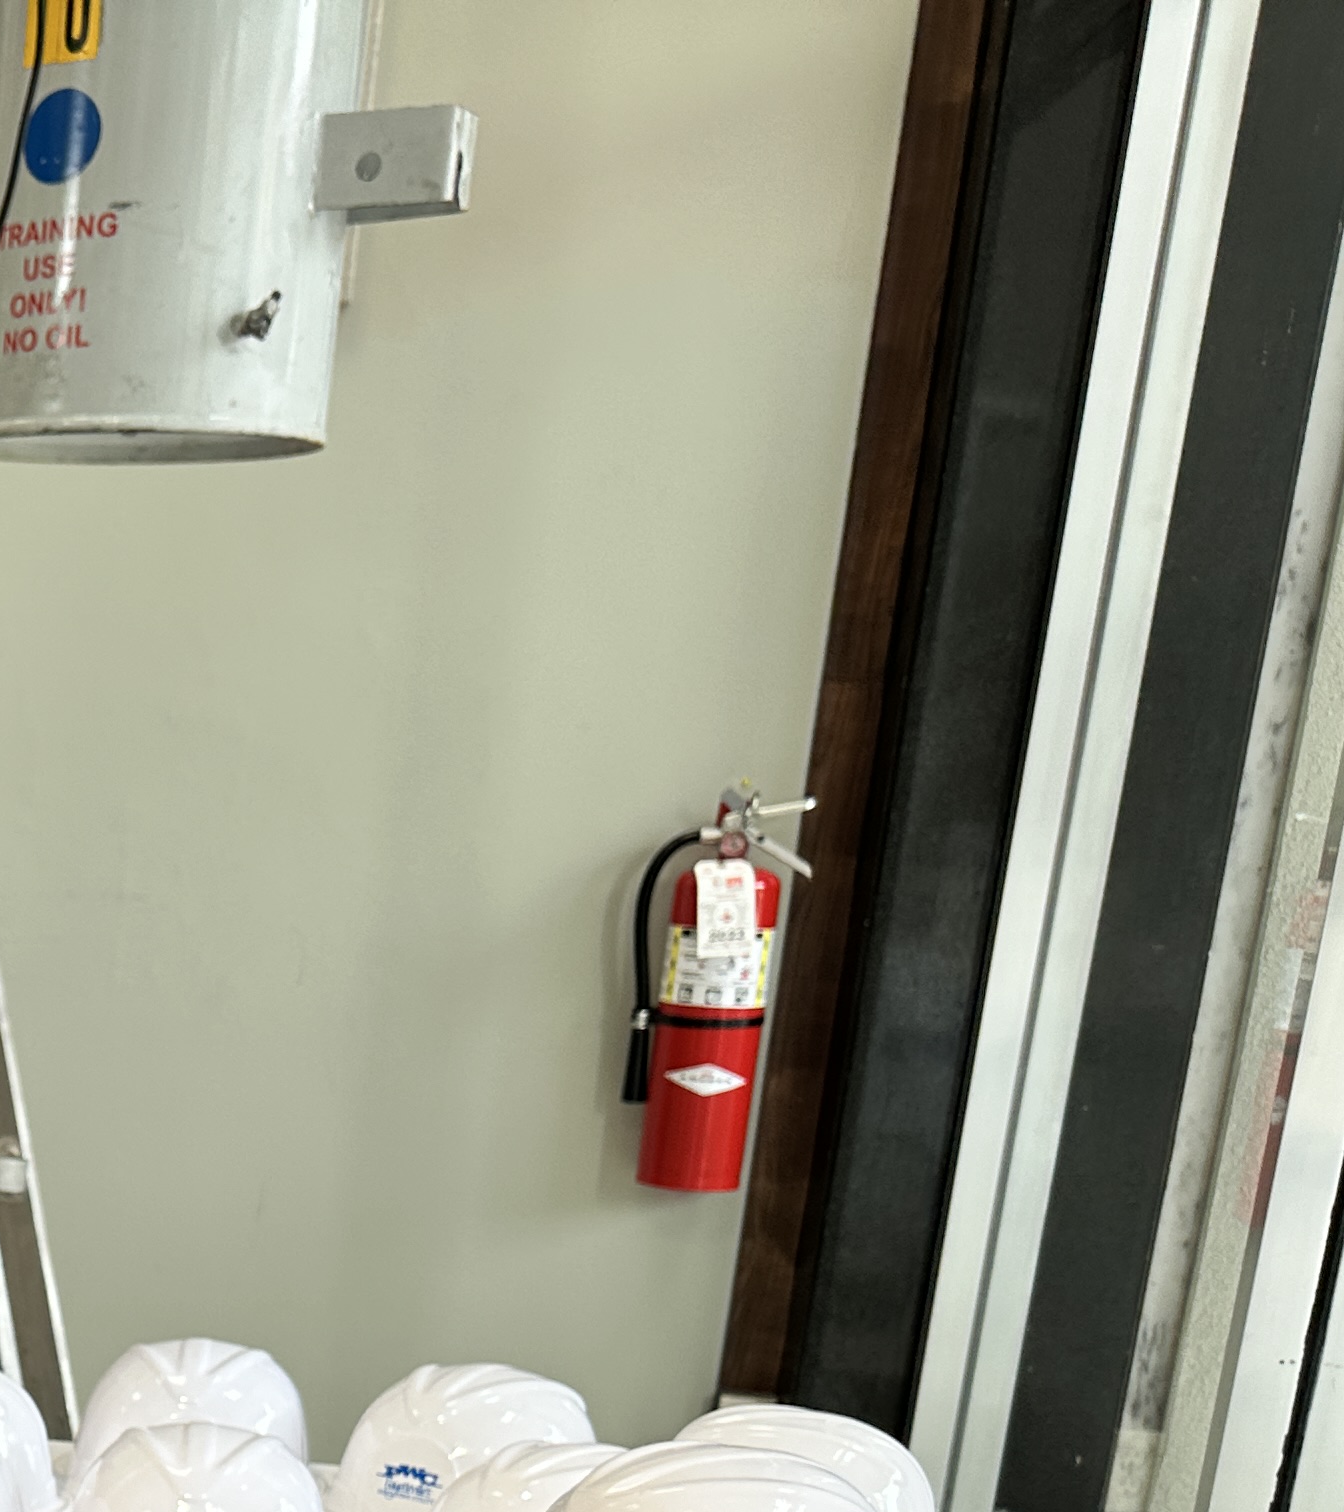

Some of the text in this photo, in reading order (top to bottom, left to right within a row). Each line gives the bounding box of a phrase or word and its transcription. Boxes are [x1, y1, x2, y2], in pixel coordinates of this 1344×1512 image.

[23, 253, 74, 282] USE
[10, 287, 87, 320] ONLY!
[3, 324, 91, 355] NO OIL
